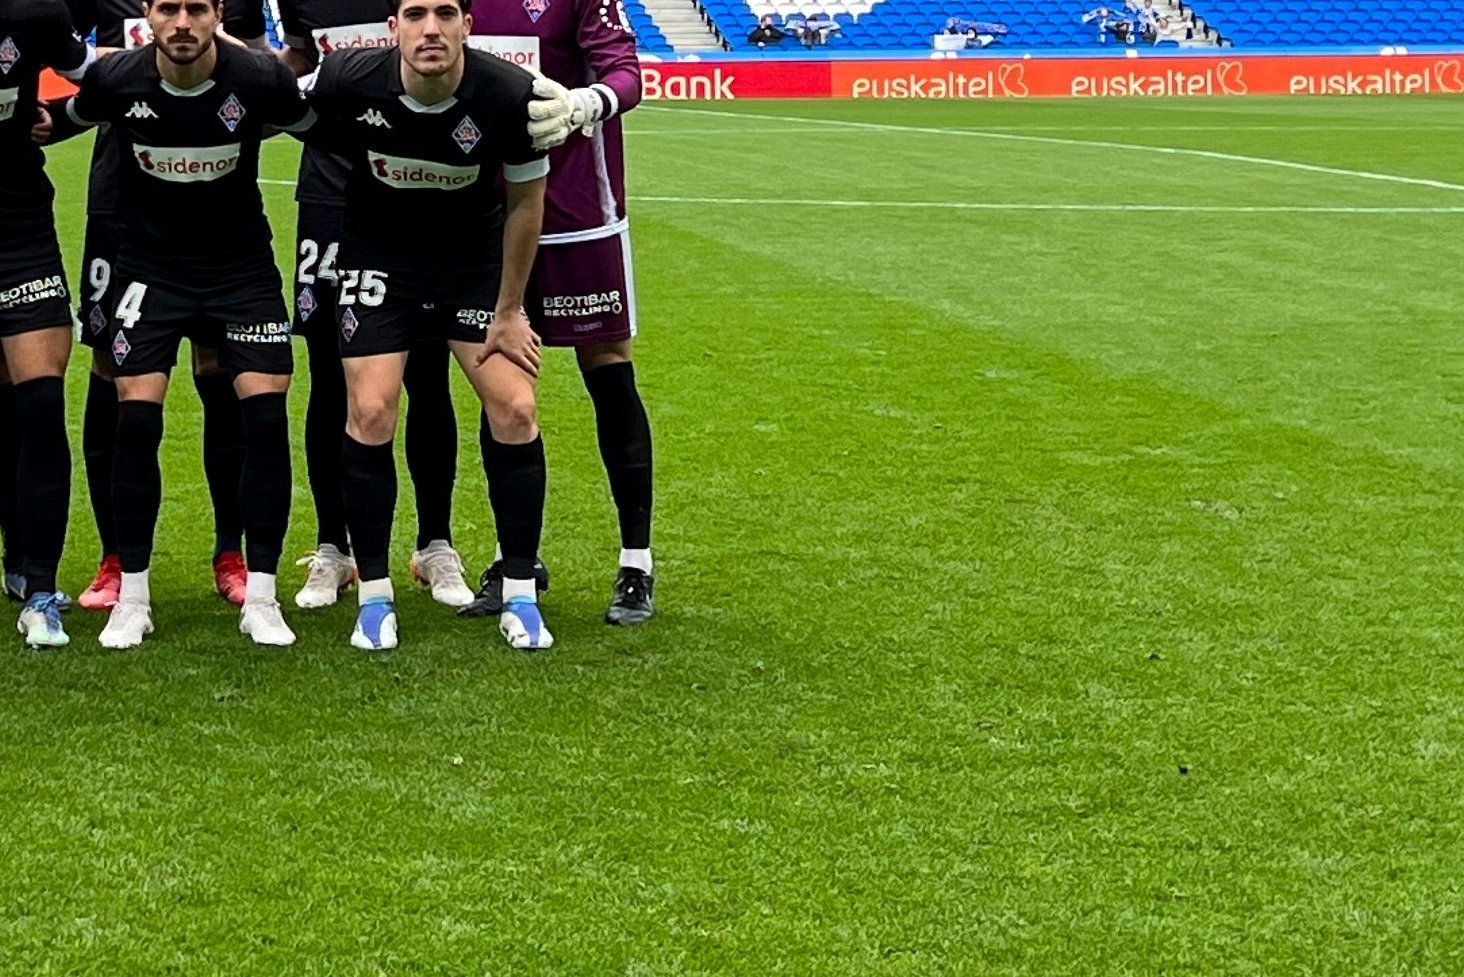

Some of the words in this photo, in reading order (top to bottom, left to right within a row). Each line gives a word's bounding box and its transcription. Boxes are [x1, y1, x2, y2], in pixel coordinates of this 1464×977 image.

[851, 68, 994, 99] euskaltel
[1070, 66, 1214, 98] euskaltel
[1289, 64, 1432, 95] euskaltel
[156, 154, 237, 175] sidenor
[391, 166, 476, 185] sidenor
[298, 238, 339, 287] 24
[338, 269, 389, 307] 25
[542, 290, 620, 308] BEOTIBAR
[115, 281, 142, 329] 4
[544, 305, 611, 317] RECYCLING
